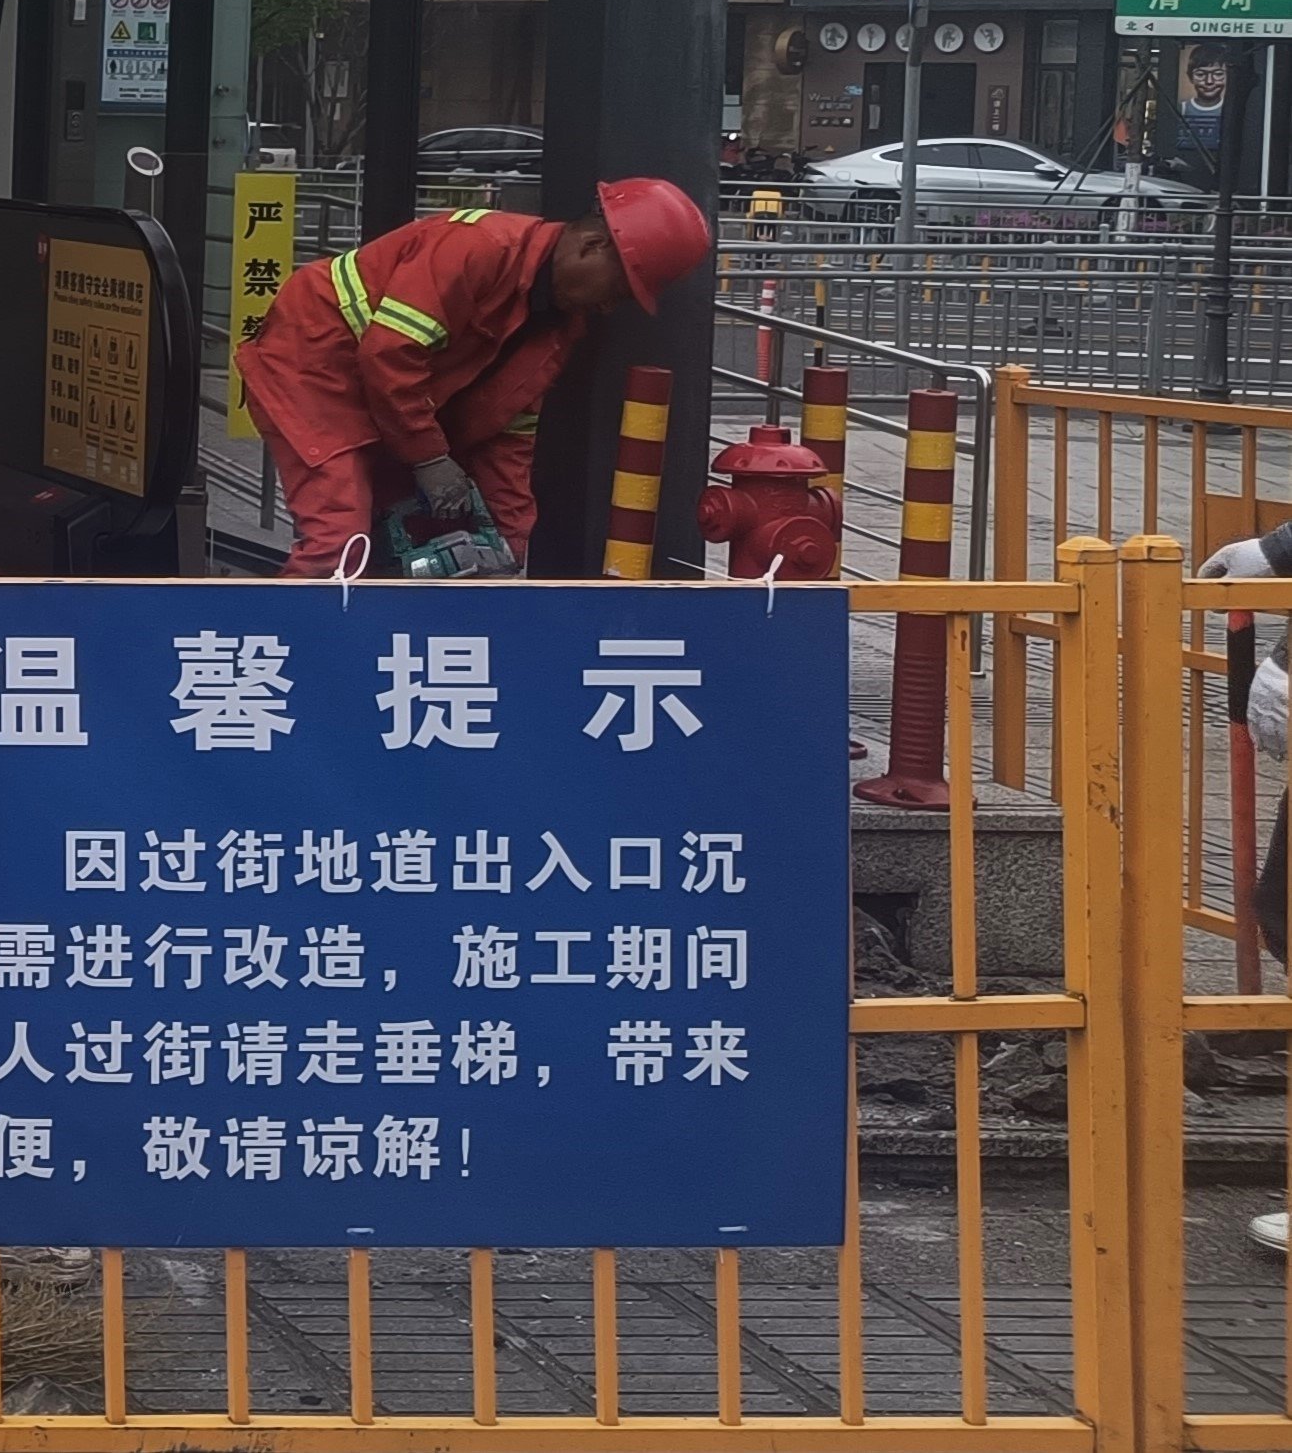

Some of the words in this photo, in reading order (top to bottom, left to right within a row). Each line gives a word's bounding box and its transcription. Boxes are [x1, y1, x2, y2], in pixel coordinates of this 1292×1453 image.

[1190, 22, 1255, 33] QINGHE
[1263, 24, 1284, 34] LU
[237, 202, 284, 410] 严禁
[62, 827, 747, 896] 因过街地道出入口沉
